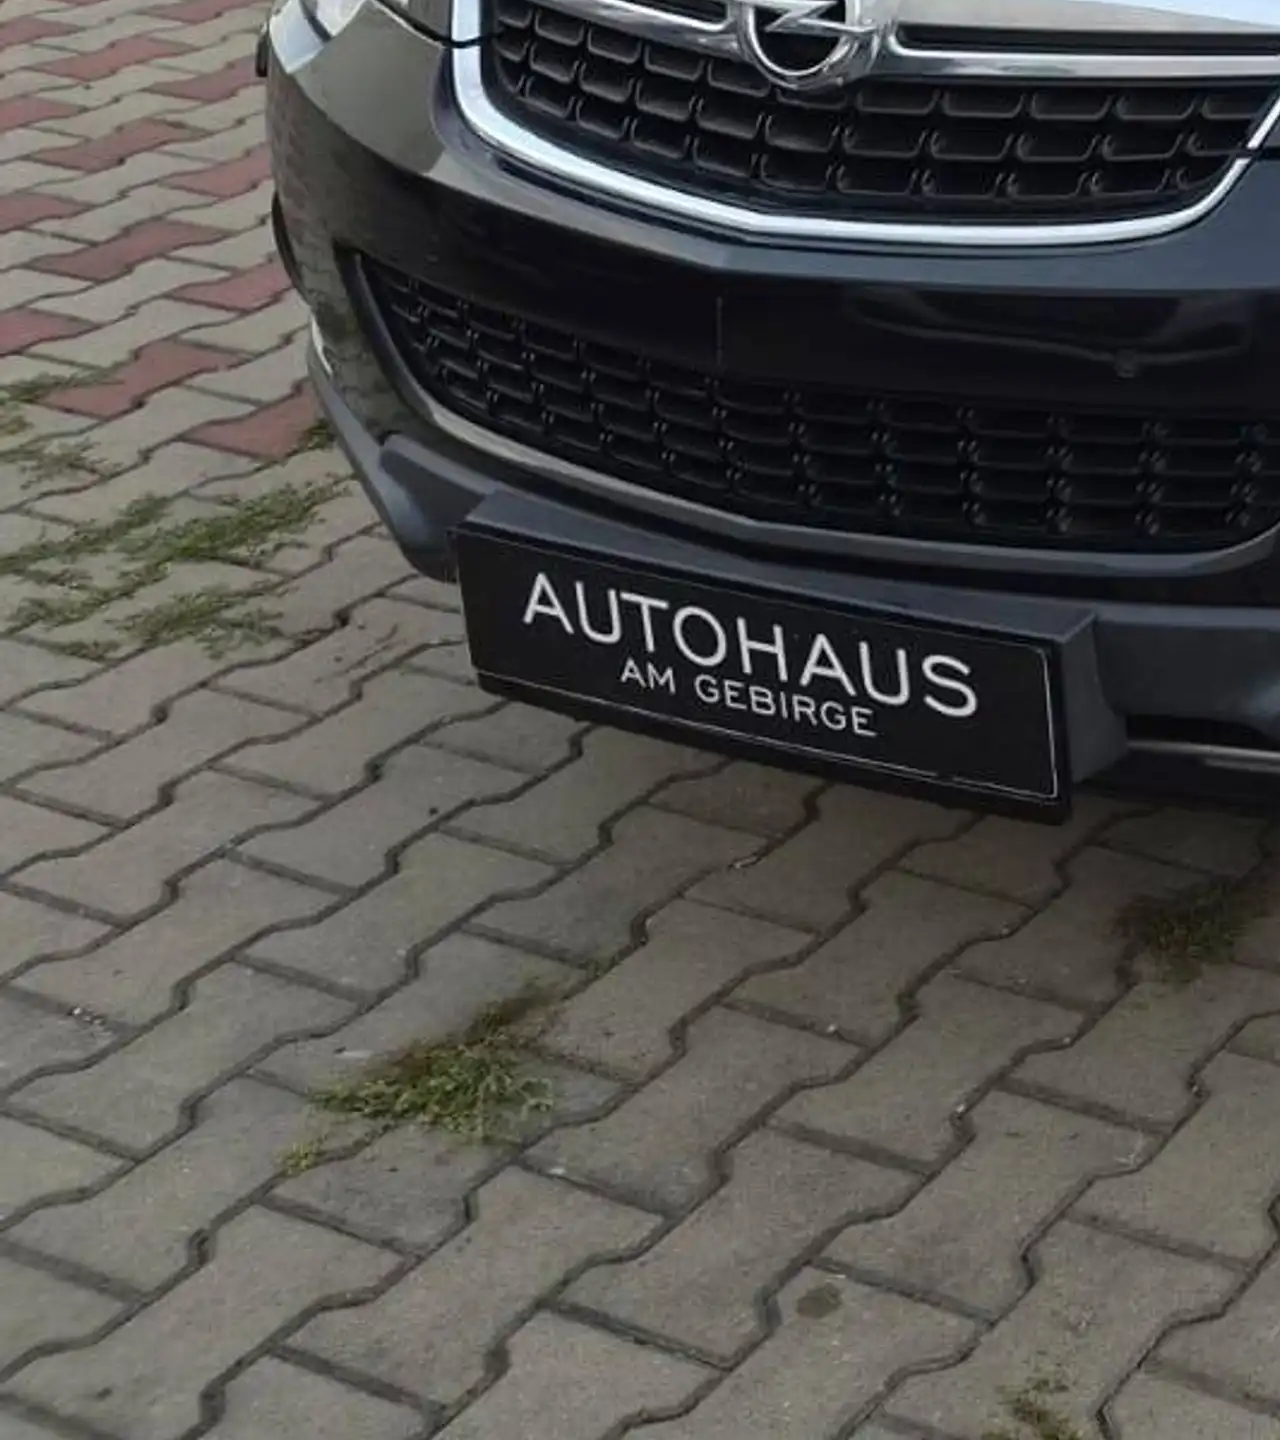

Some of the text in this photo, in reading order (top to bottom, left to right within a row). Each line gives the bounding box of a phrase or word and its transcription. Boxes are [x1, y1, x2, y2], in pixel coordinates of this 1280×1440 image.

[523, 572, 978, 717] AUTOHAUS
[620, 658, 878, 737] AM GEBIRGE
